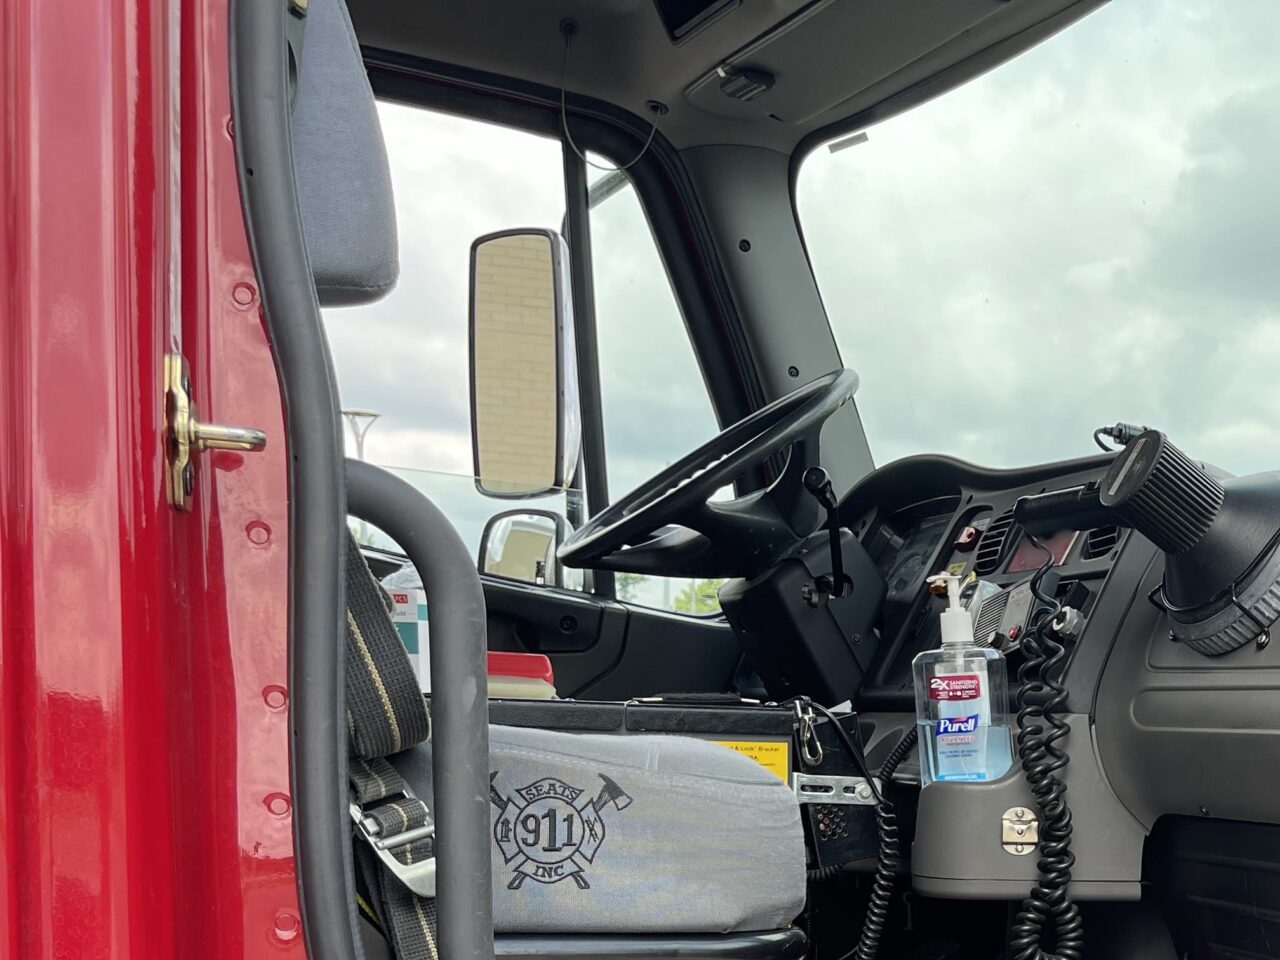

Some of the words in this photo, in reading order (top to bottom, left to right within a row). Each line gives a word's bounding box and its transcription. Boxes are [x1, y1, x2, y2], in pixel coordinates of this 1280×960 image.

[939, 718, 975, 733] Purell
[525, 783, 579, 800] SEATS
[519, 808, 577, 852] 911
[532, 864, 566, 878] INC
